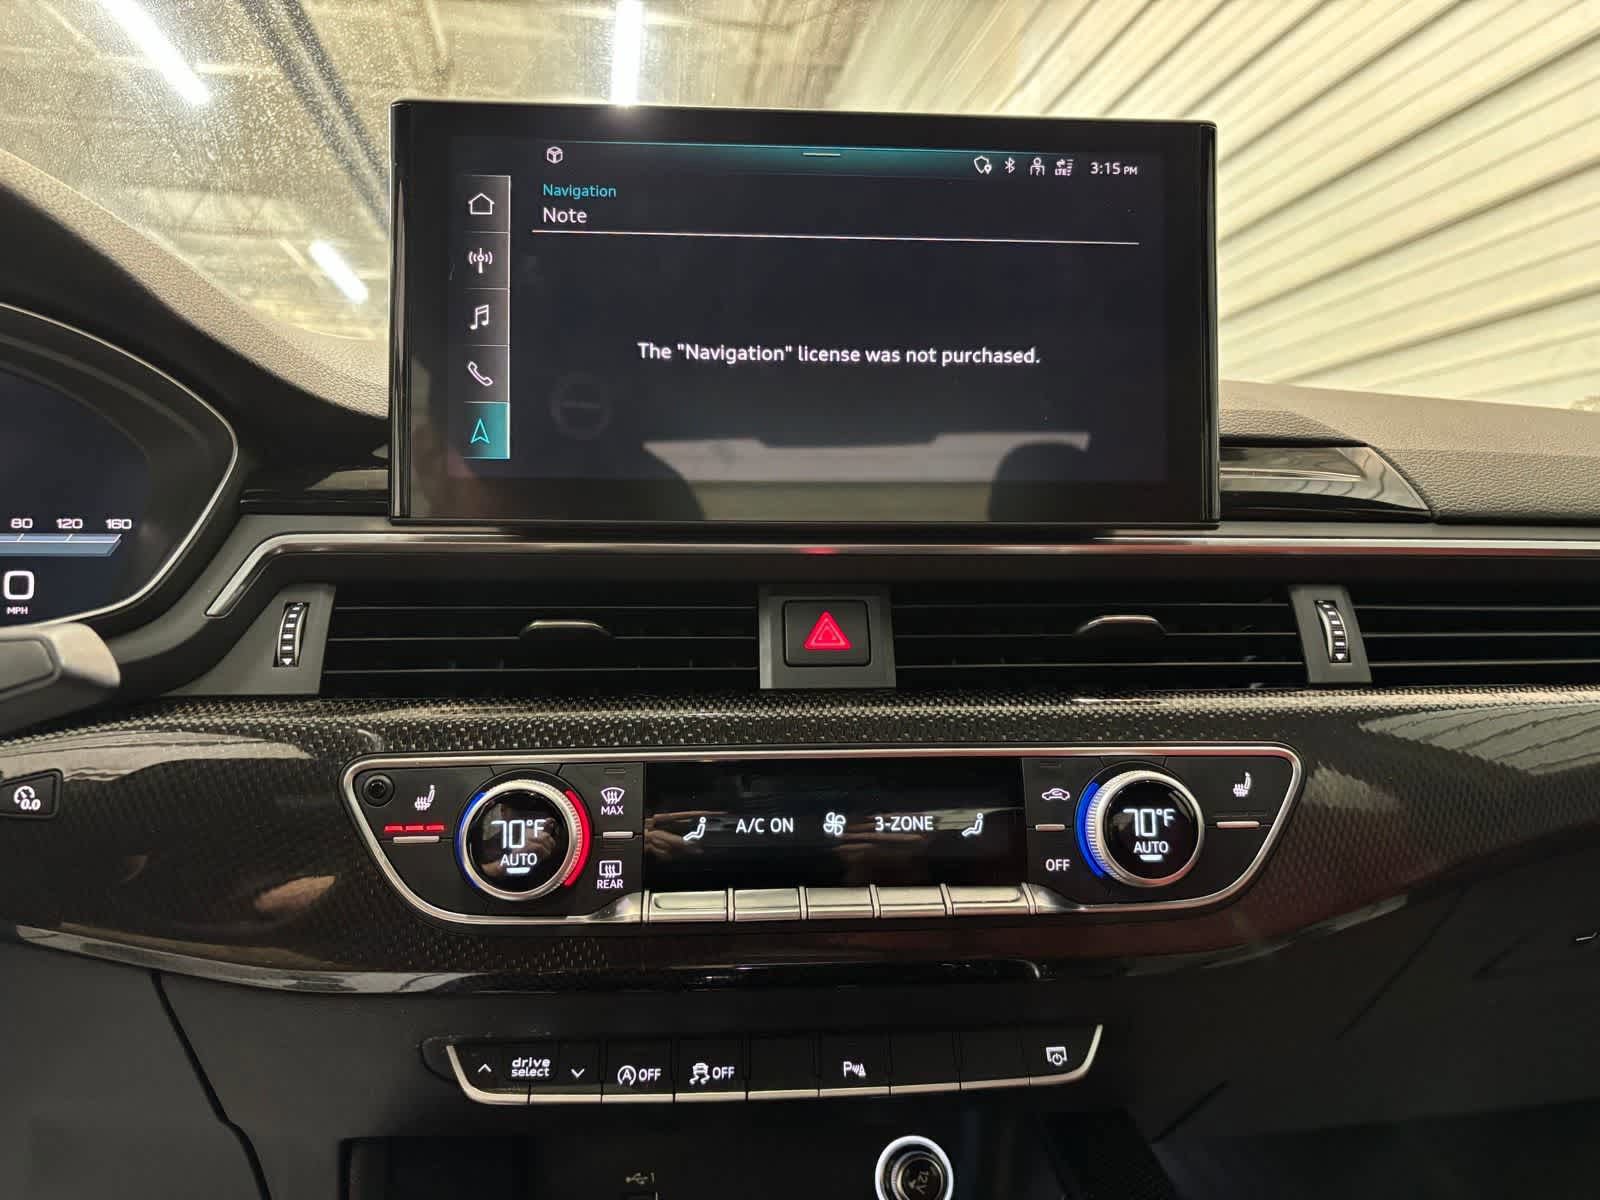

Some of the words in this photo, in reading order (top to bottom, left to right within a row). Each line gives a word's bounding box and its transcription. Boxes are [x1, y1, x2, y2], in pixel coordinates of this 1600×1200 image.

[1090, 162, 1121, 175] 3:15
[1123, 166, 1138, 175] PM
[542, 183, 617, 199] Navigation
[542, 207, 588, 224] Note
[637, 342, 672, 360] The
[677, 343, 792, 364] "Navigation"
[798, 345, 861, 362] license
[865, 350, 901, 363] was
[906, 347, 937, 363] not
[941, 346, 1041, 367] purchased.
[10, 518, 34, 529] 80
[56, 518, 83, 529] 120
[105, 518, 133, 530] 160
[3, 570, 35, 600] 0
[6, 606, 28, 615] MPH
[600, 805, 625, 816] MAX
[735, 817, 765, 834] A/C
[770, 817, 794, 833] ON
[874, 815, 934, 832] 3-ZONE
[1122, 808, 1176, 837] 70°F
[491, 819, 547, 849] 70°F
[1133, 841, 1169, 854] AUTO
[500, 853, 538, 866] AUTO
[1045, 859, 1070, 872] OFF
[597, 879, 624, 889] REAR
[511, 1057, 550, 1068] drive
[511, 1067, 550, 1078] select
[638, 1068, 662, 1081] OFF
[712, 1066, 735, 1080] OFF
